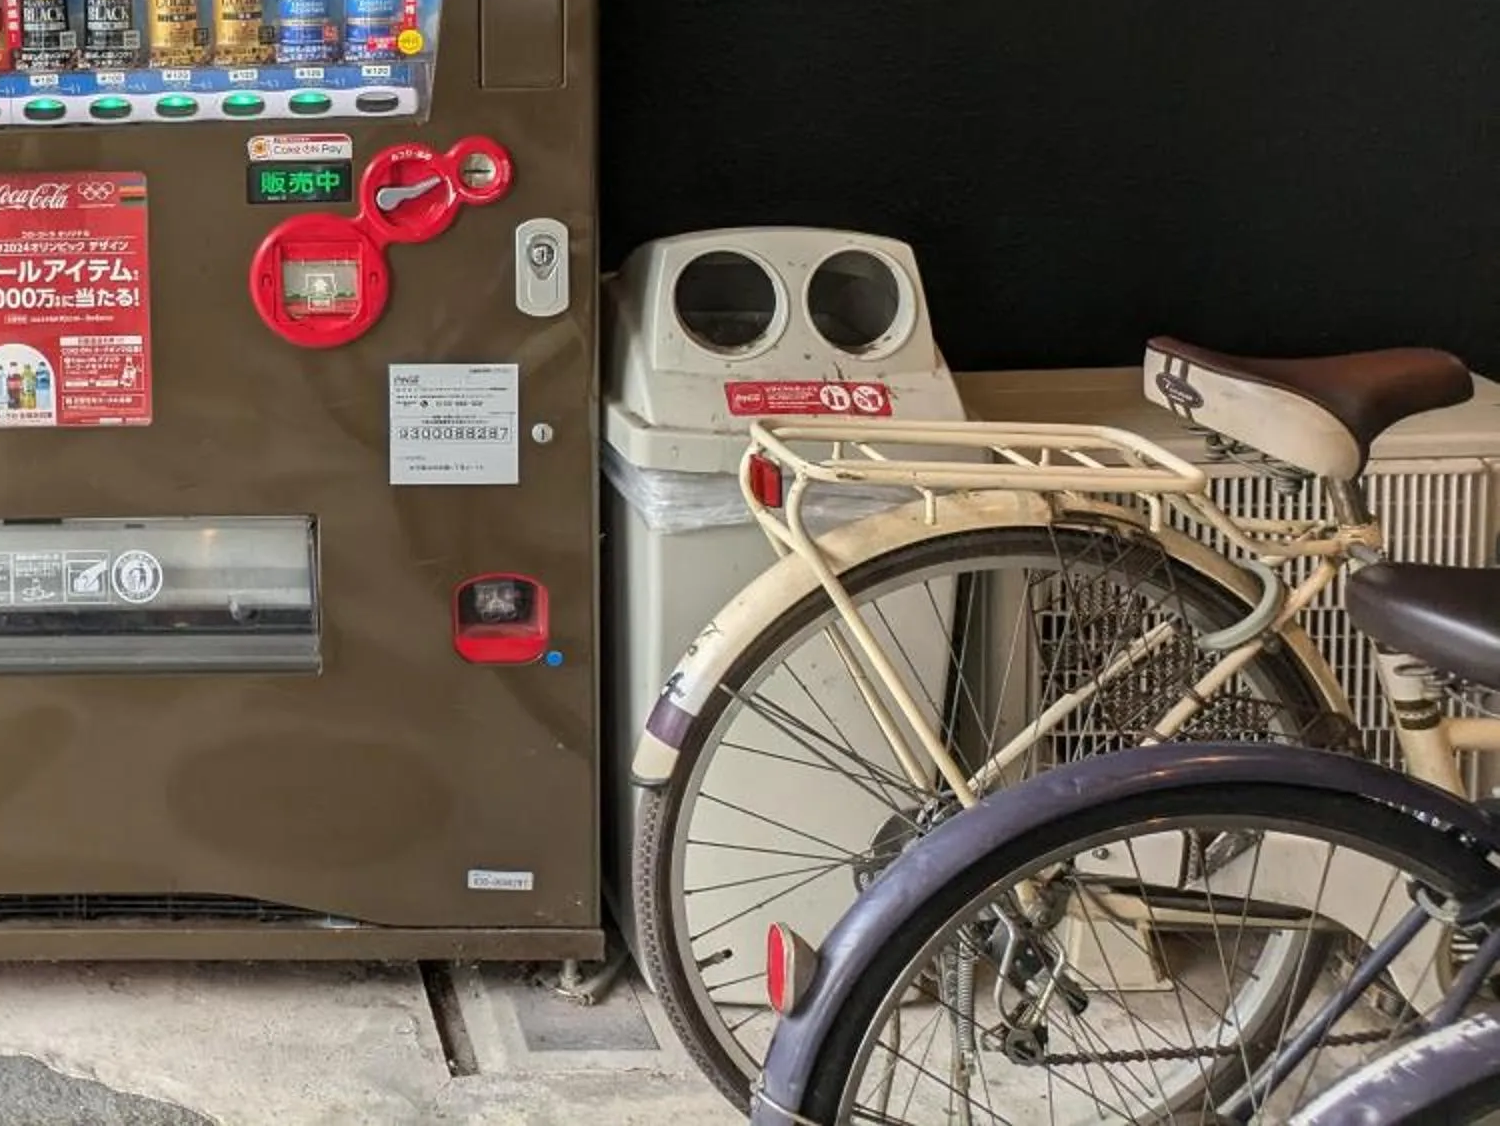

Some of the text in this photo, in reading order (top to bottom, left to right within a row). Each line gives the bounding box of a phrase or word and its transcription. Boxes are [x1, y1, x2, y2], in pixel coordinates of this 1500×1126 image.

[88, 5, 129, 21] BLACK
[322, 144, 343, 156] Pay
[261, 171, 340, 193] 販売中
